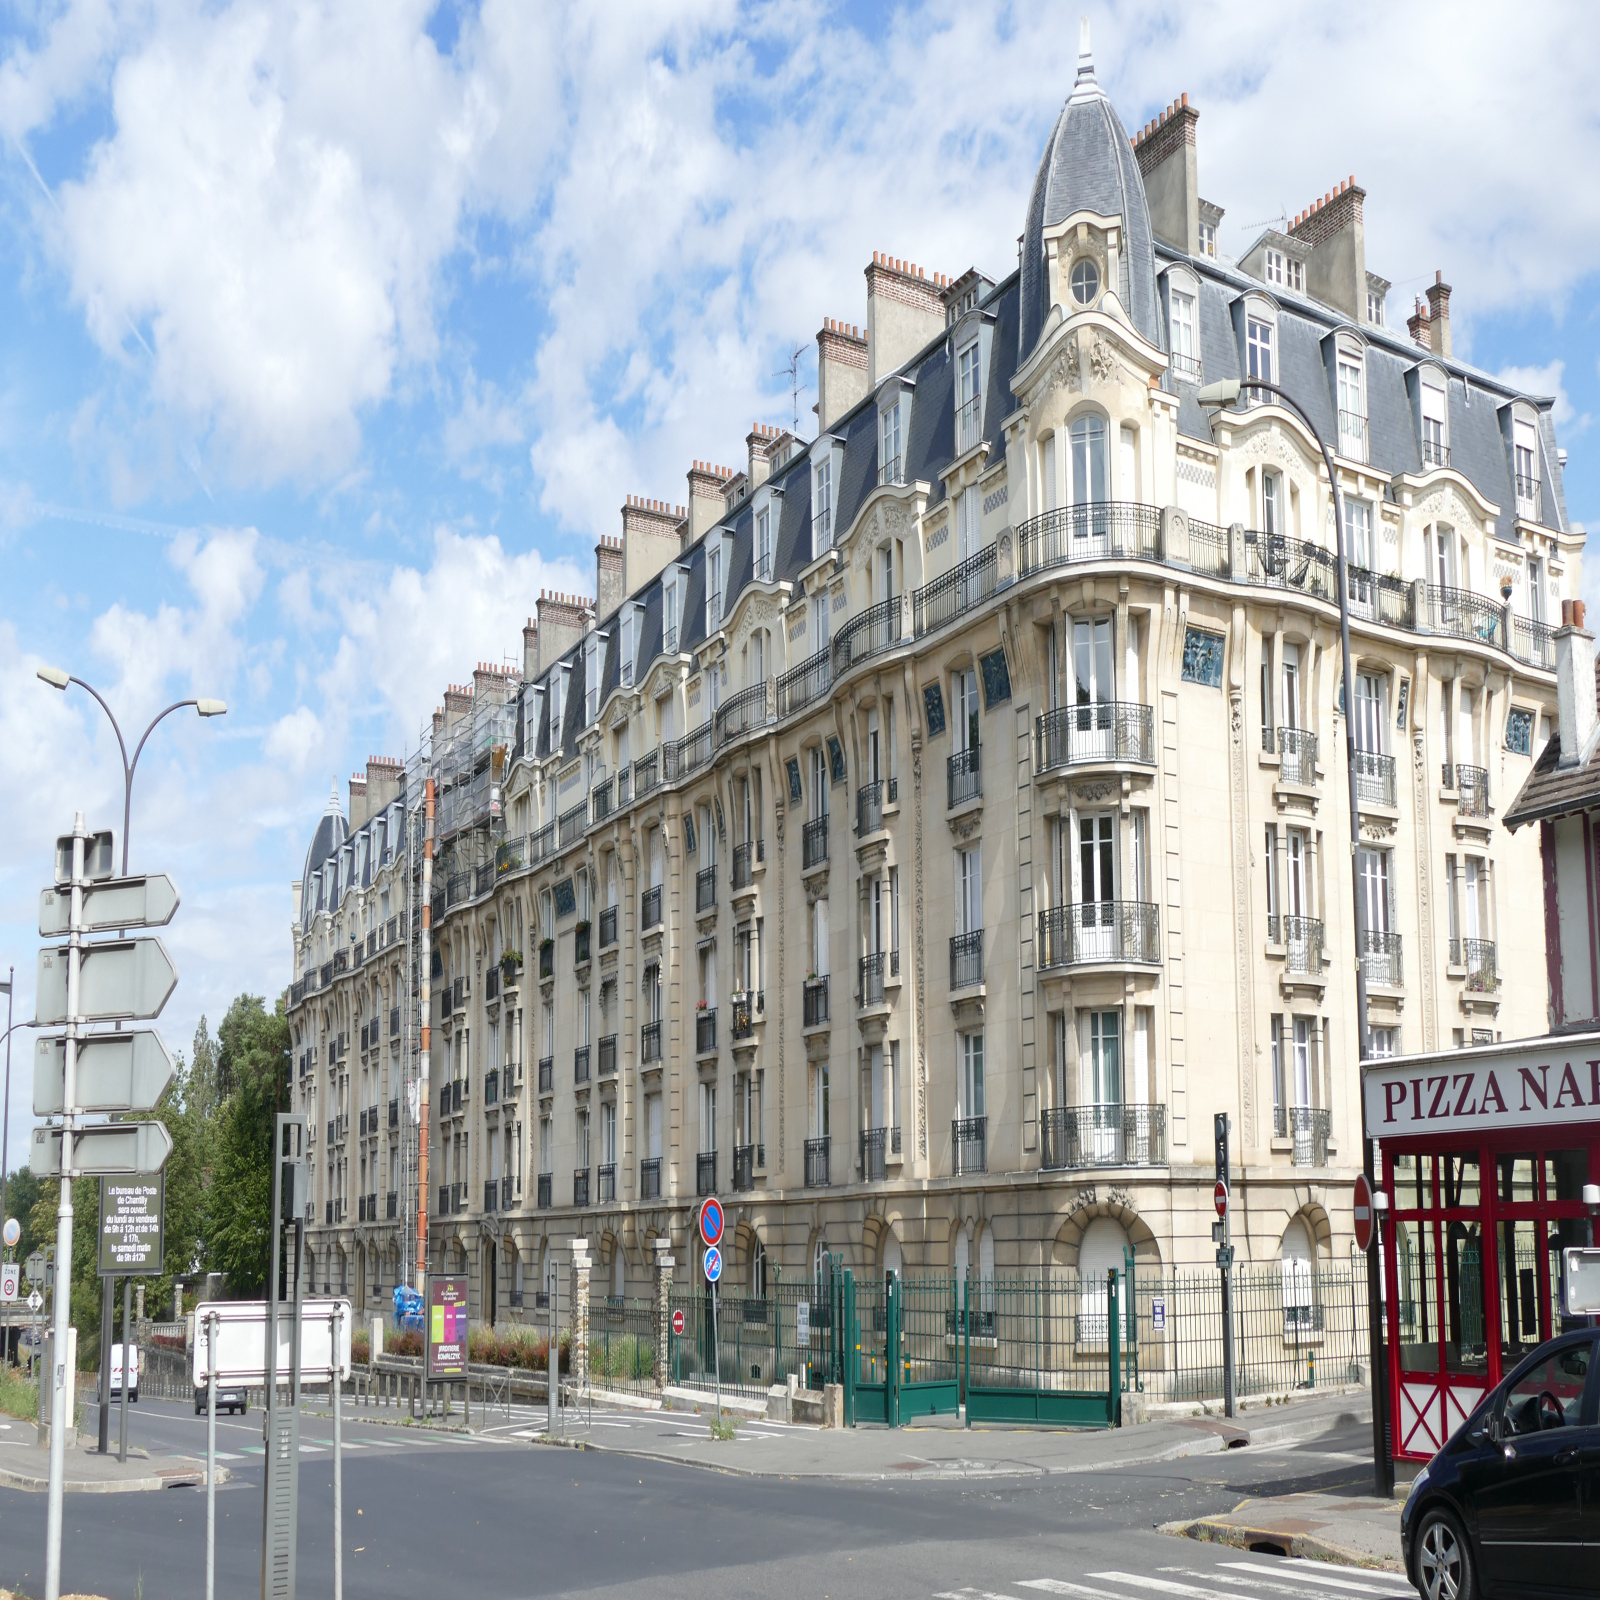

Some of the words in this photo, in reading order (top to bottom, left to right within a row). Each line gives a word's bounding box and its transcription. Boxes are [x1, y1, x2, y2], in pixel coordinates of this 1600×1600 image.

[1382, 1070, 1508, 1123] PIZZA
[108, 1186, 115, 1195] Le
[116, 1186, 134, 1195] bureau
[135, 1186, 142, 1195] de
[143, 1186, 157, 1195] Poste
[117, 1196, 124, 1205] de
[125, 1195, 147, 1206] Chantilly
[130, 1206, 147, 1214] ouvert
[106, 1215, 113, 1223] du
[114, 1215, 127, 1223] lundi
[135, 1215, 157, 1223] vendredi
[104, 1225, 111, 1233] de
[112, 1225, 119, 1233] 9h
[125, 1224, 135, 1233] 12h
[149, 1224, 159, 1233] 14h
[111, 1244, 117, 1252] le
[117, 1244, 136, 1252] samedi
[136, 1244, 151, 1252] matin
[116, 1253, 124, 1262] de
[124, 1253, 131, 1262] 9h
